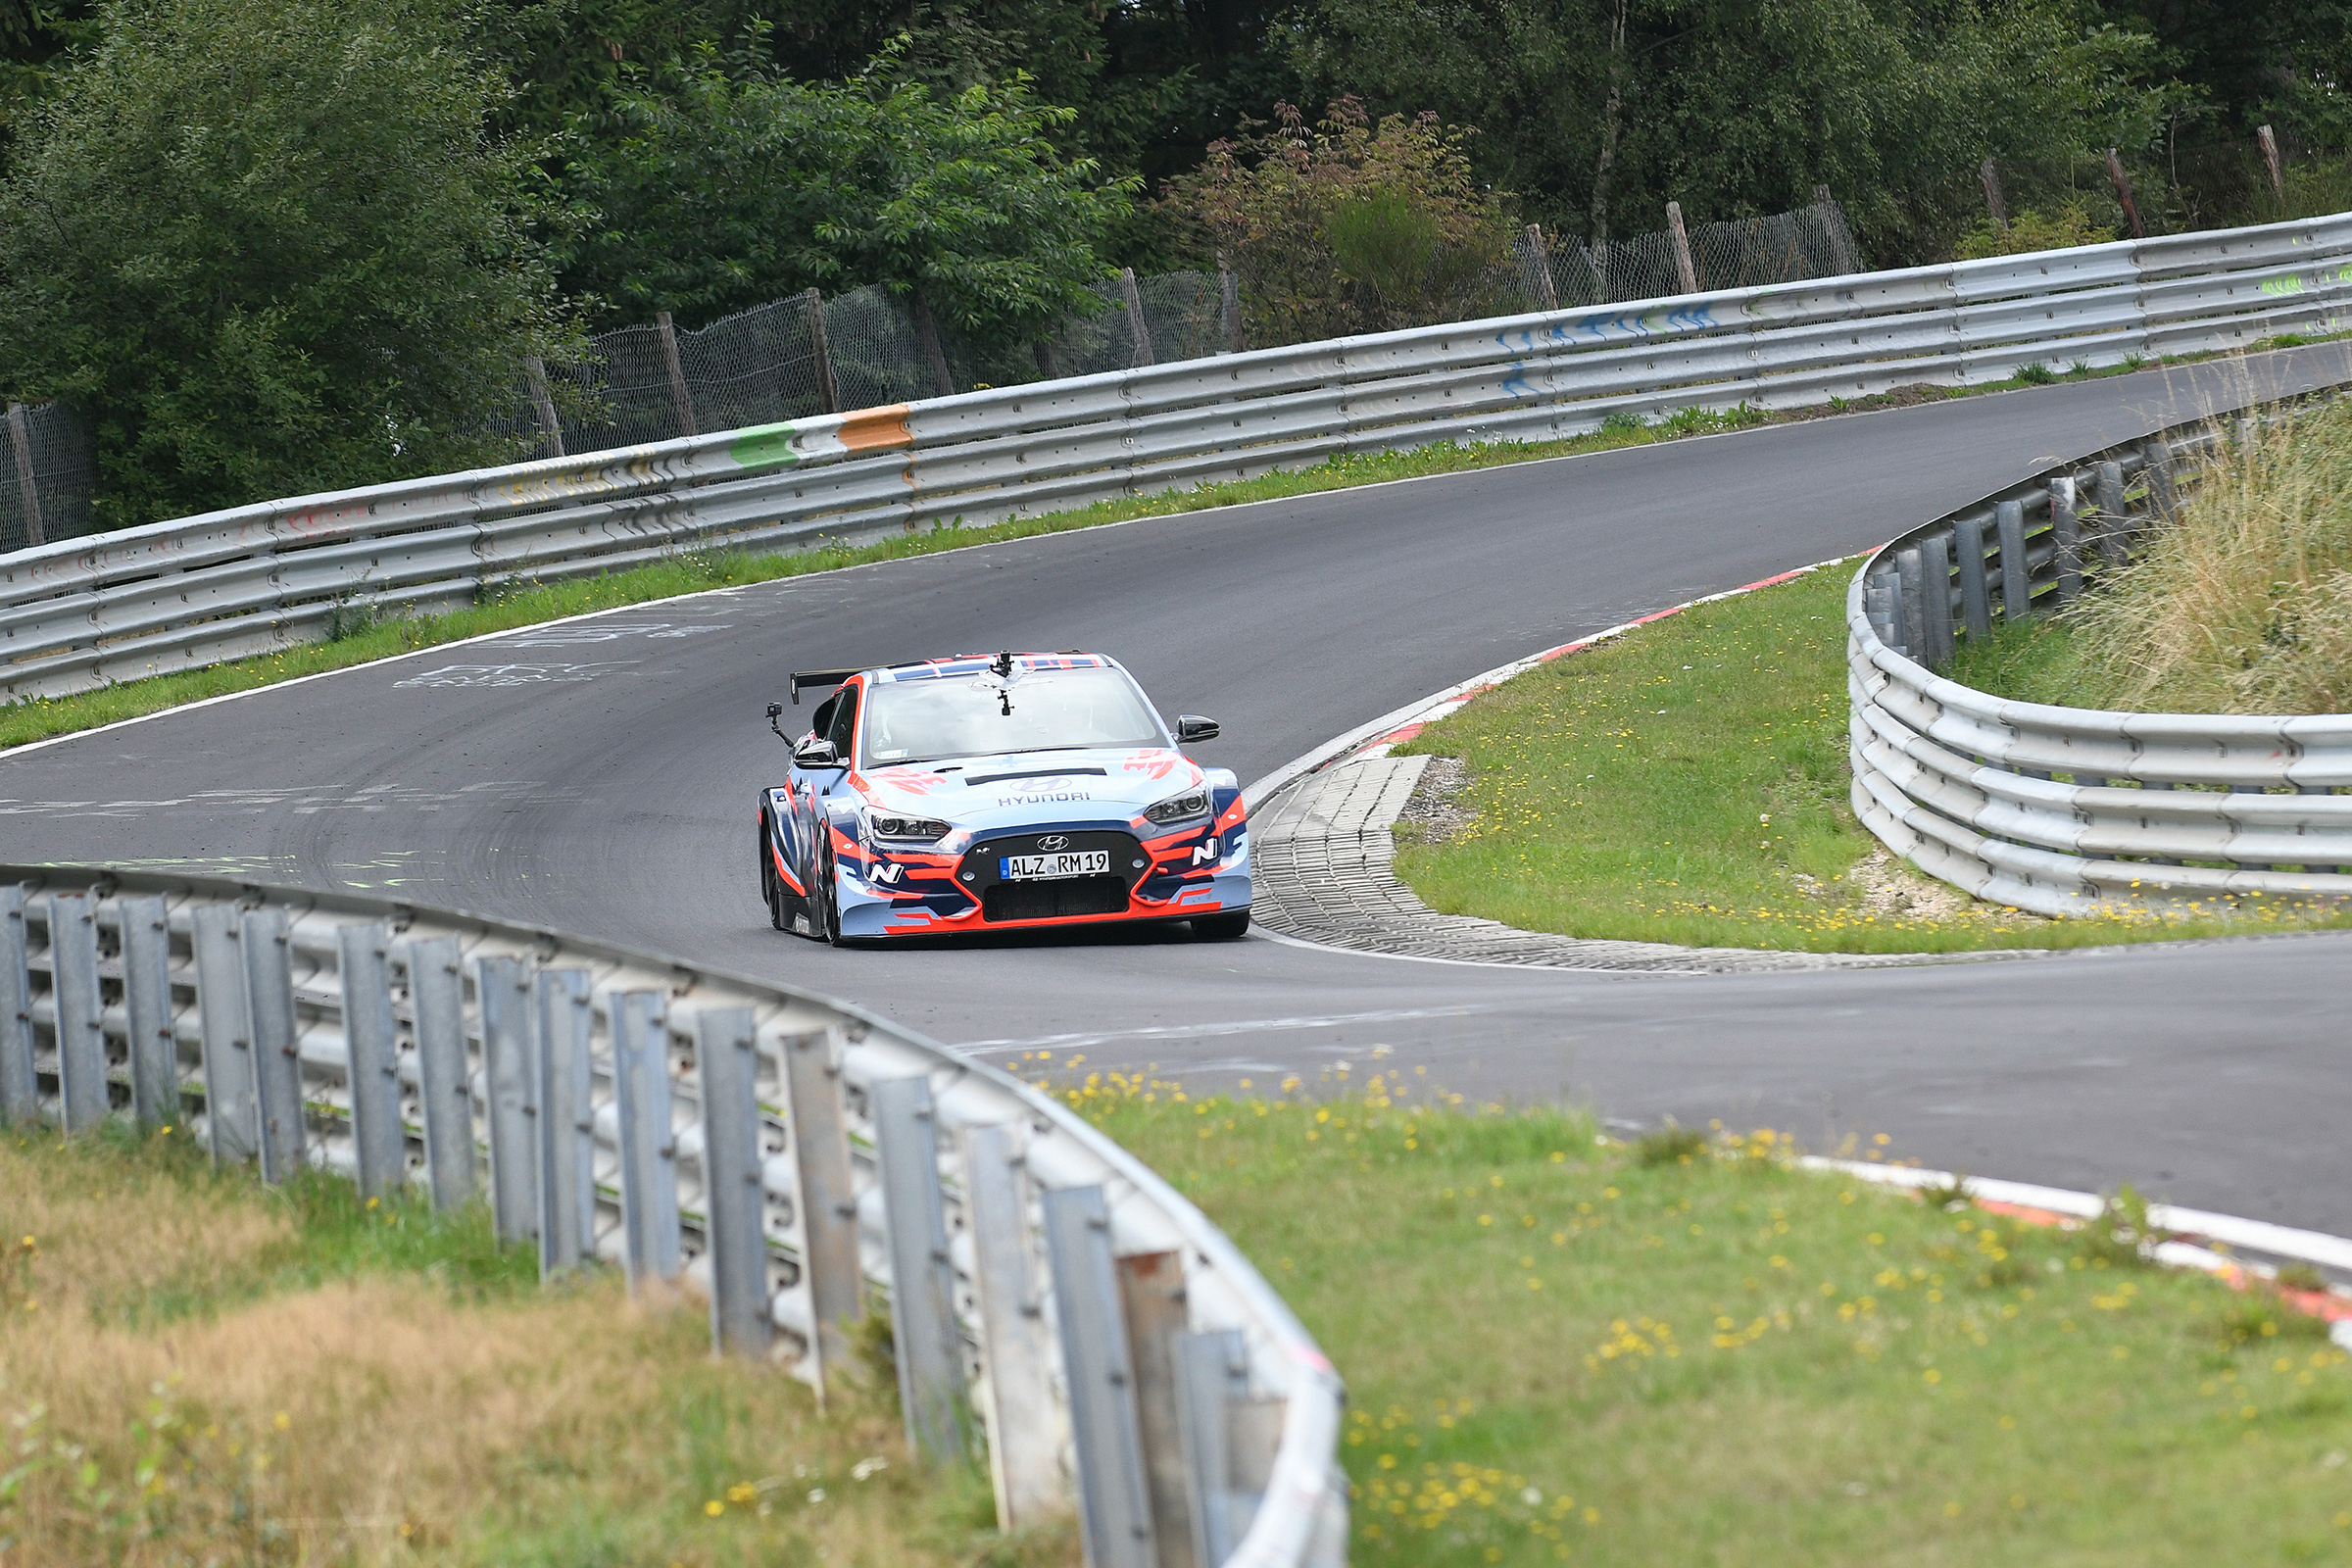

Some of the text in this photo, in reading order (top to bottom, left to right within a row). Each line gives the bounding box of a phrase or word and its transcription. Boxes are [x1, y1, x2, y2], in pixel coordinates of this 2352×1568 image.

[998, 792, 1091, 807] HYUNDAI
[1011, 854, 1106, 876] ALZ RM 19
